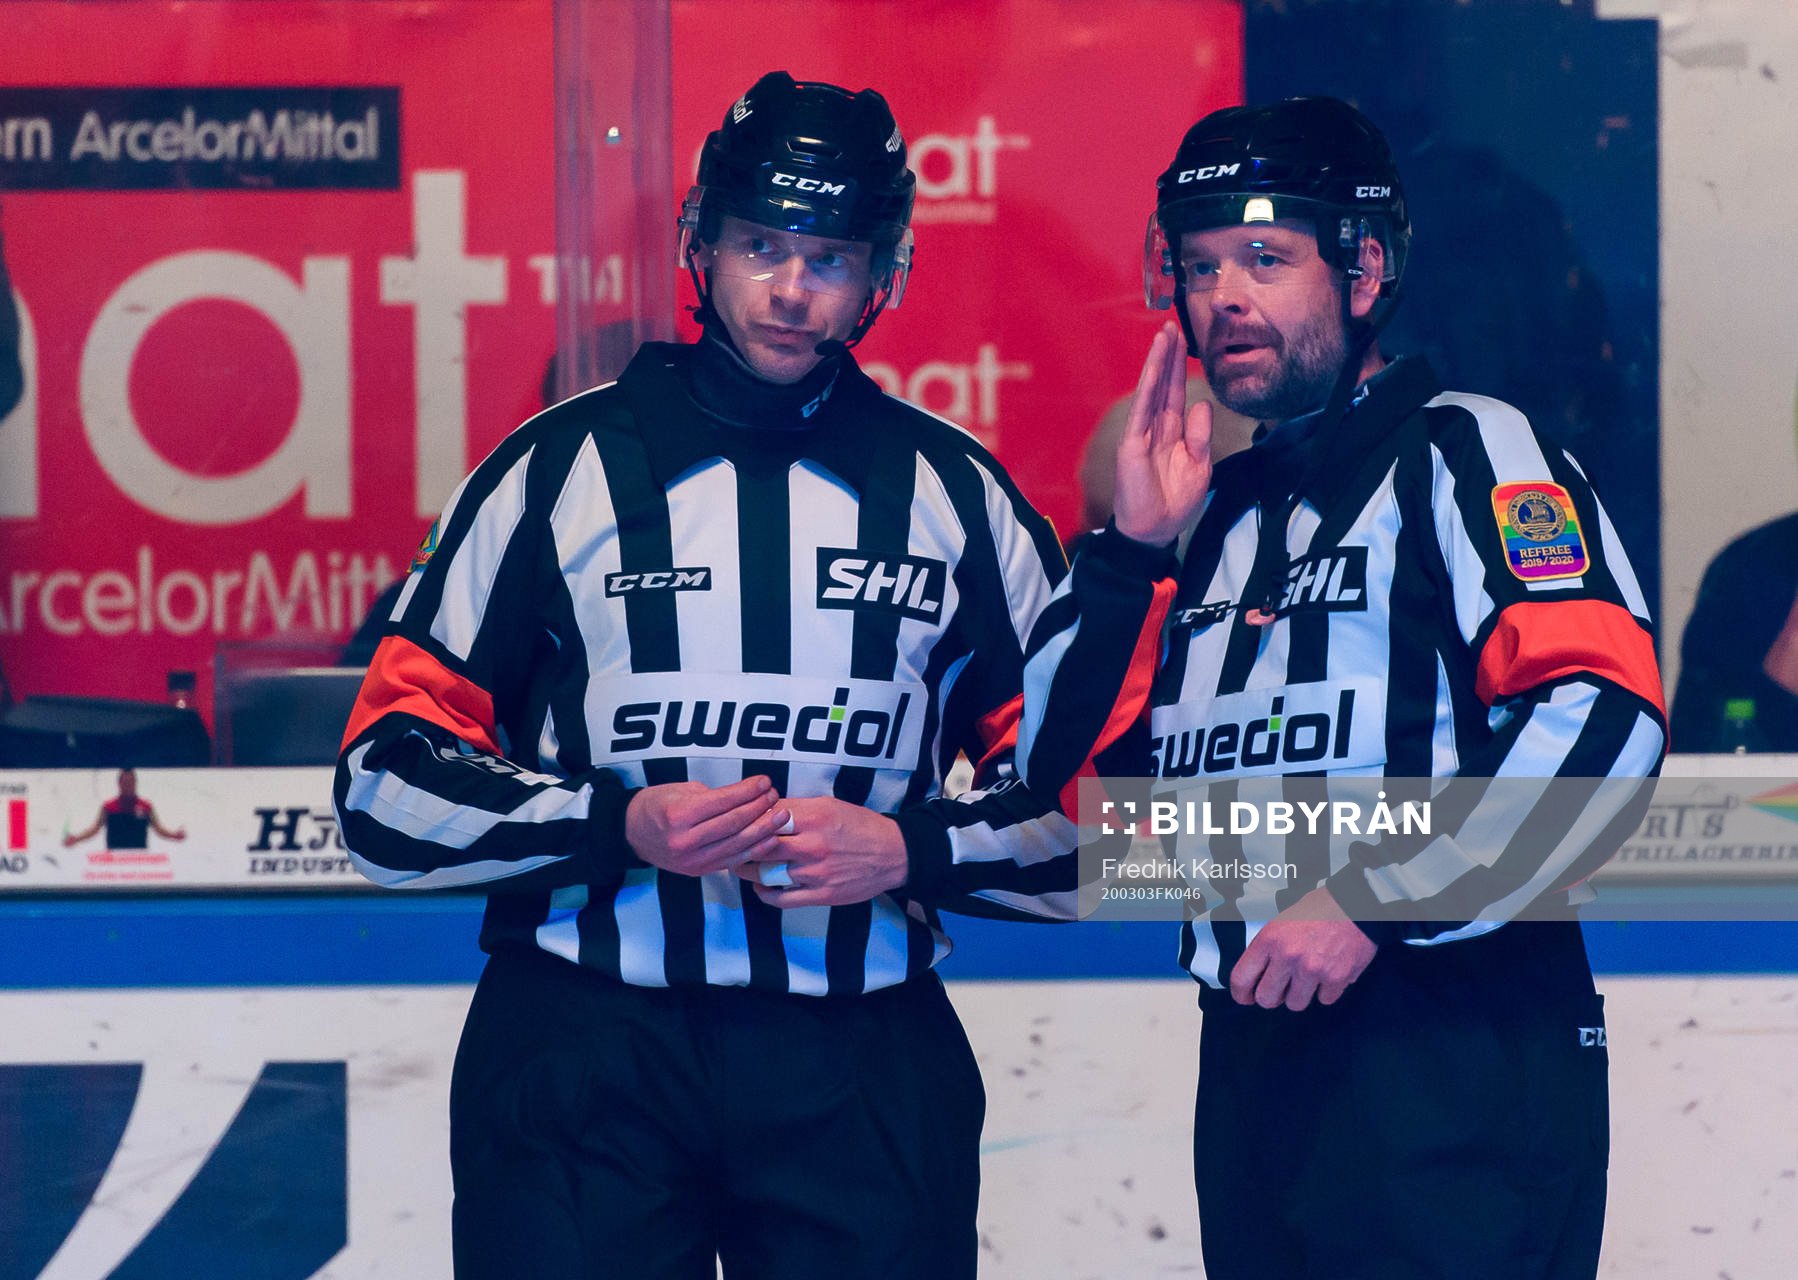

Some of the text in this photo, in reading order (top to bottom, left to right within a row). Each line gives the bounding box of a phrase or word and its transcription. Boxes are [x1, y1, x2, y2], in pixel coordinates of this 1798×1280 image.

[0, 106, 379, 163] rn ArcelorMittal
[771, 172, 846, 196] CCM
[1178, 163, 1241, 184] CCM
[1355, 186, 1390, 198] CCM
[1519, 545, 1572, 559] REFEREE
[1521, 555, 1575, 569] 2019/2020
[609, 571, 708, 592] CCM
[821, 558, 940, 613] SHL
[610, 687, 912, 759] swedol
[247, 857, 354, 874] INDUST
